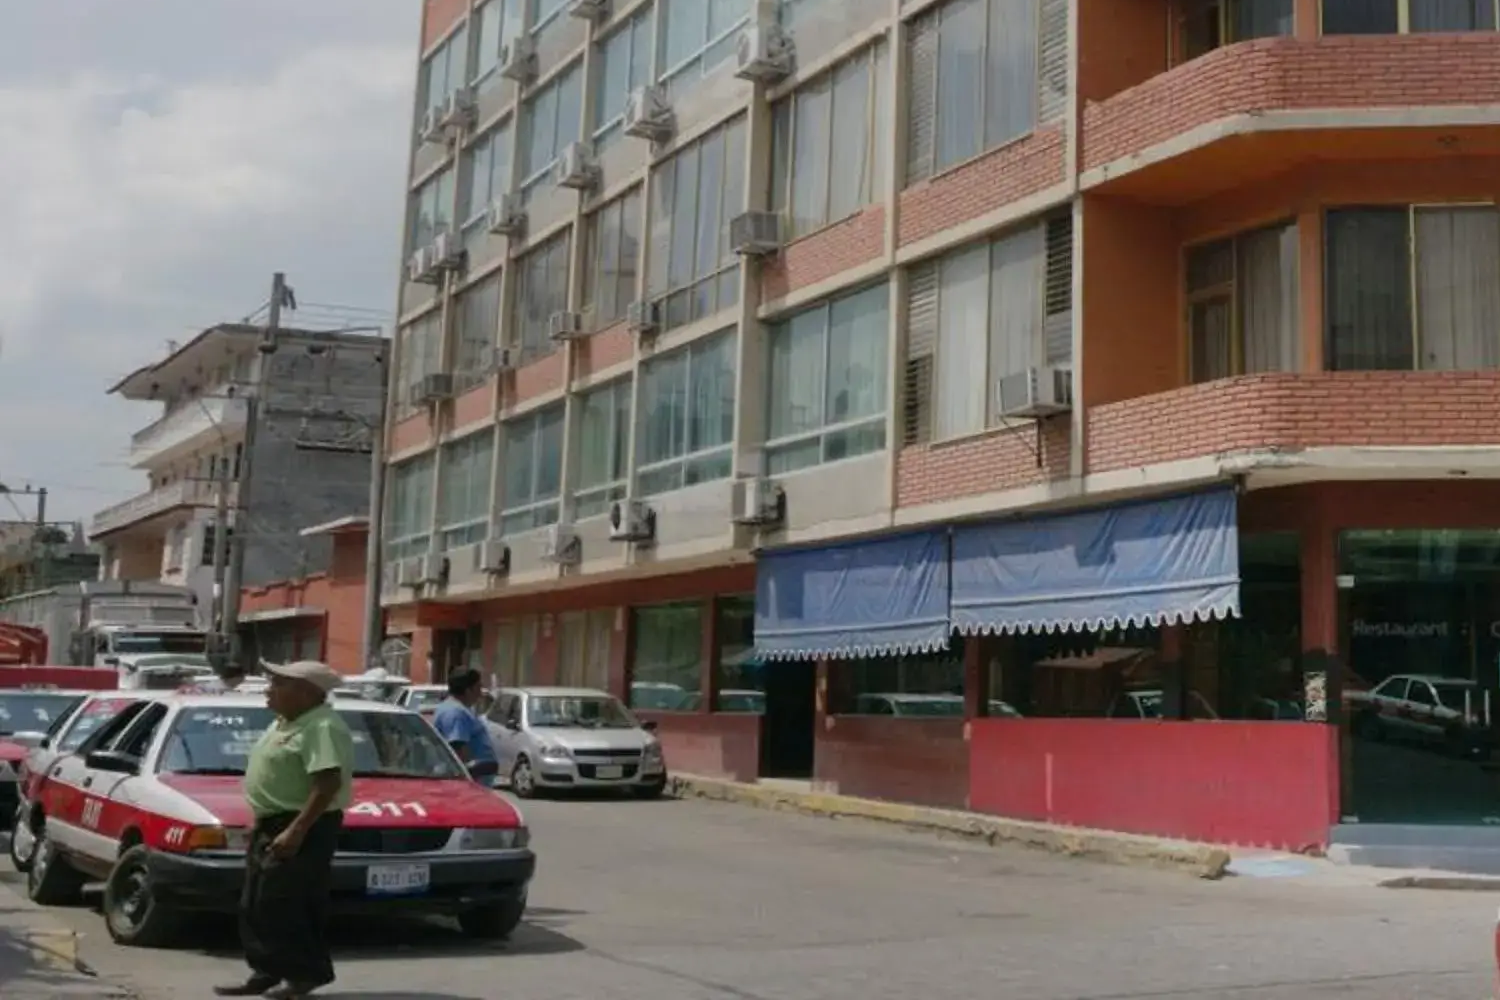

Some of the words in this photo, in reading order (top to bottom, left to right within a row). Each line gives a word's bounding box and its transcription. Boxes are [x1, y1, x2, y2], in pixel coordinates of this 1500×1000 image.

[1352, 620, 1448, 637] Restaurant
[347, 801, 428, 818] 411
[163, 825, 186, 844] 411
